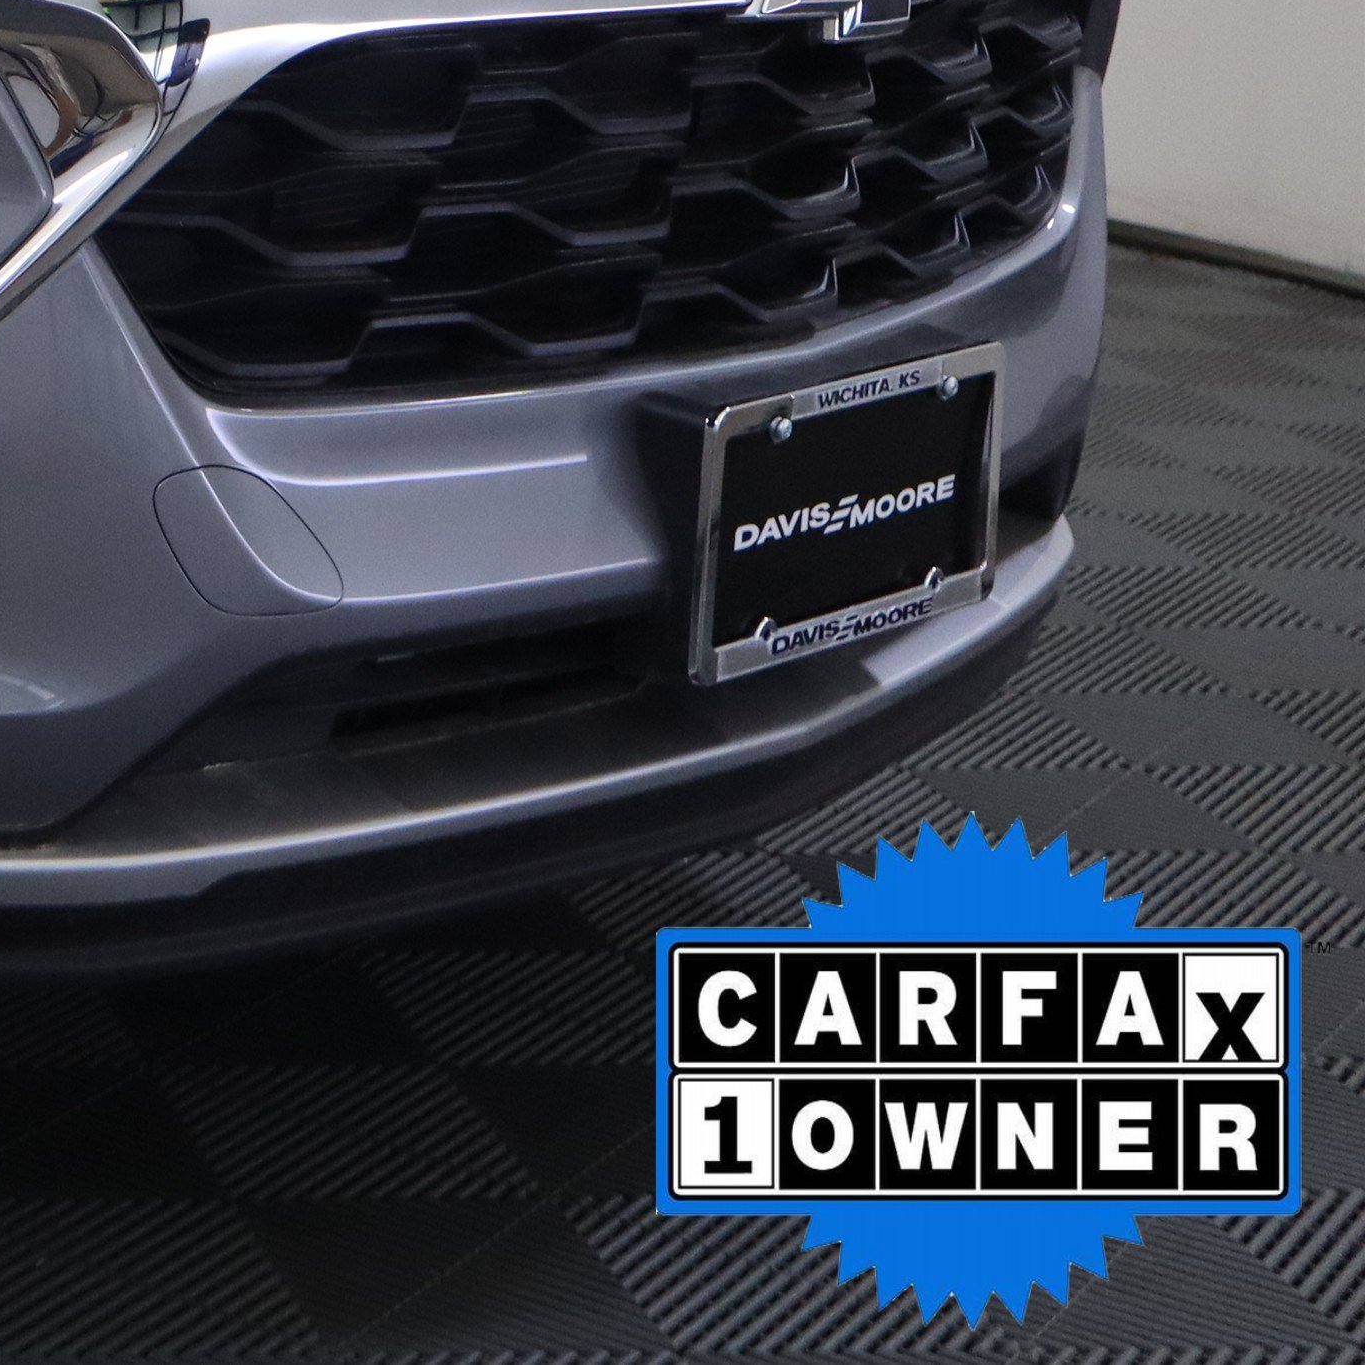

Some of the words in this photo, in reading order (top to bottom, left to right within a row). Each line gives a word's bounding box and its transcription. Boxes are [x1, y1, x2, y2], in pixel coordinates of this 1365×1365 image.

[898, 370, 920, 389] KS
[734, 502, 831, 552] DAVIS
[849, 474, 956, 528] MOORE
[771, 620, 840, 656] DAVIS
[853, 597, 933, 640] MOORE
